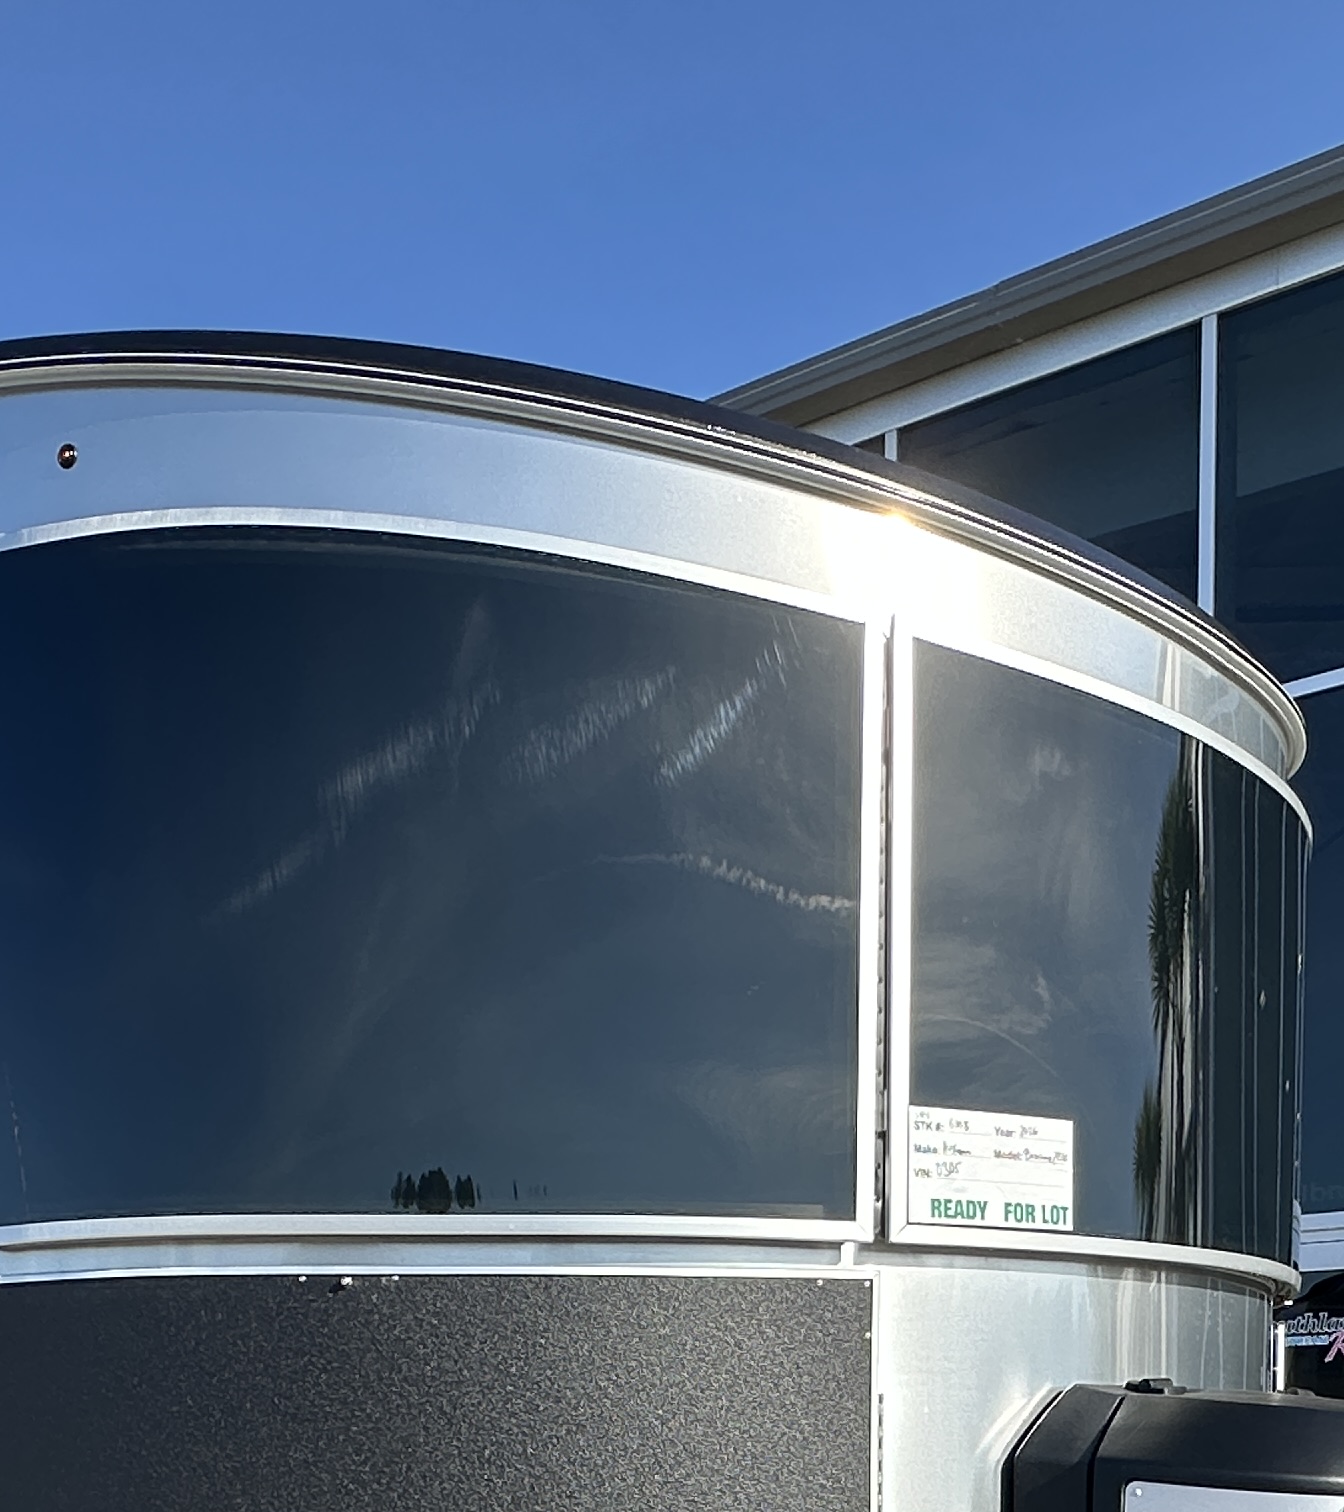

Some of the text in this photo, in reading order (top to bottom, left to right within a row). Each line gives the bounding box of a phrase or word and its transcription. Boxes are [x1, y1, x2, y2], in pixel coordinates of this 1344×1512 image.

[930, 1198, 1069, 1226] READY FOR LOT
